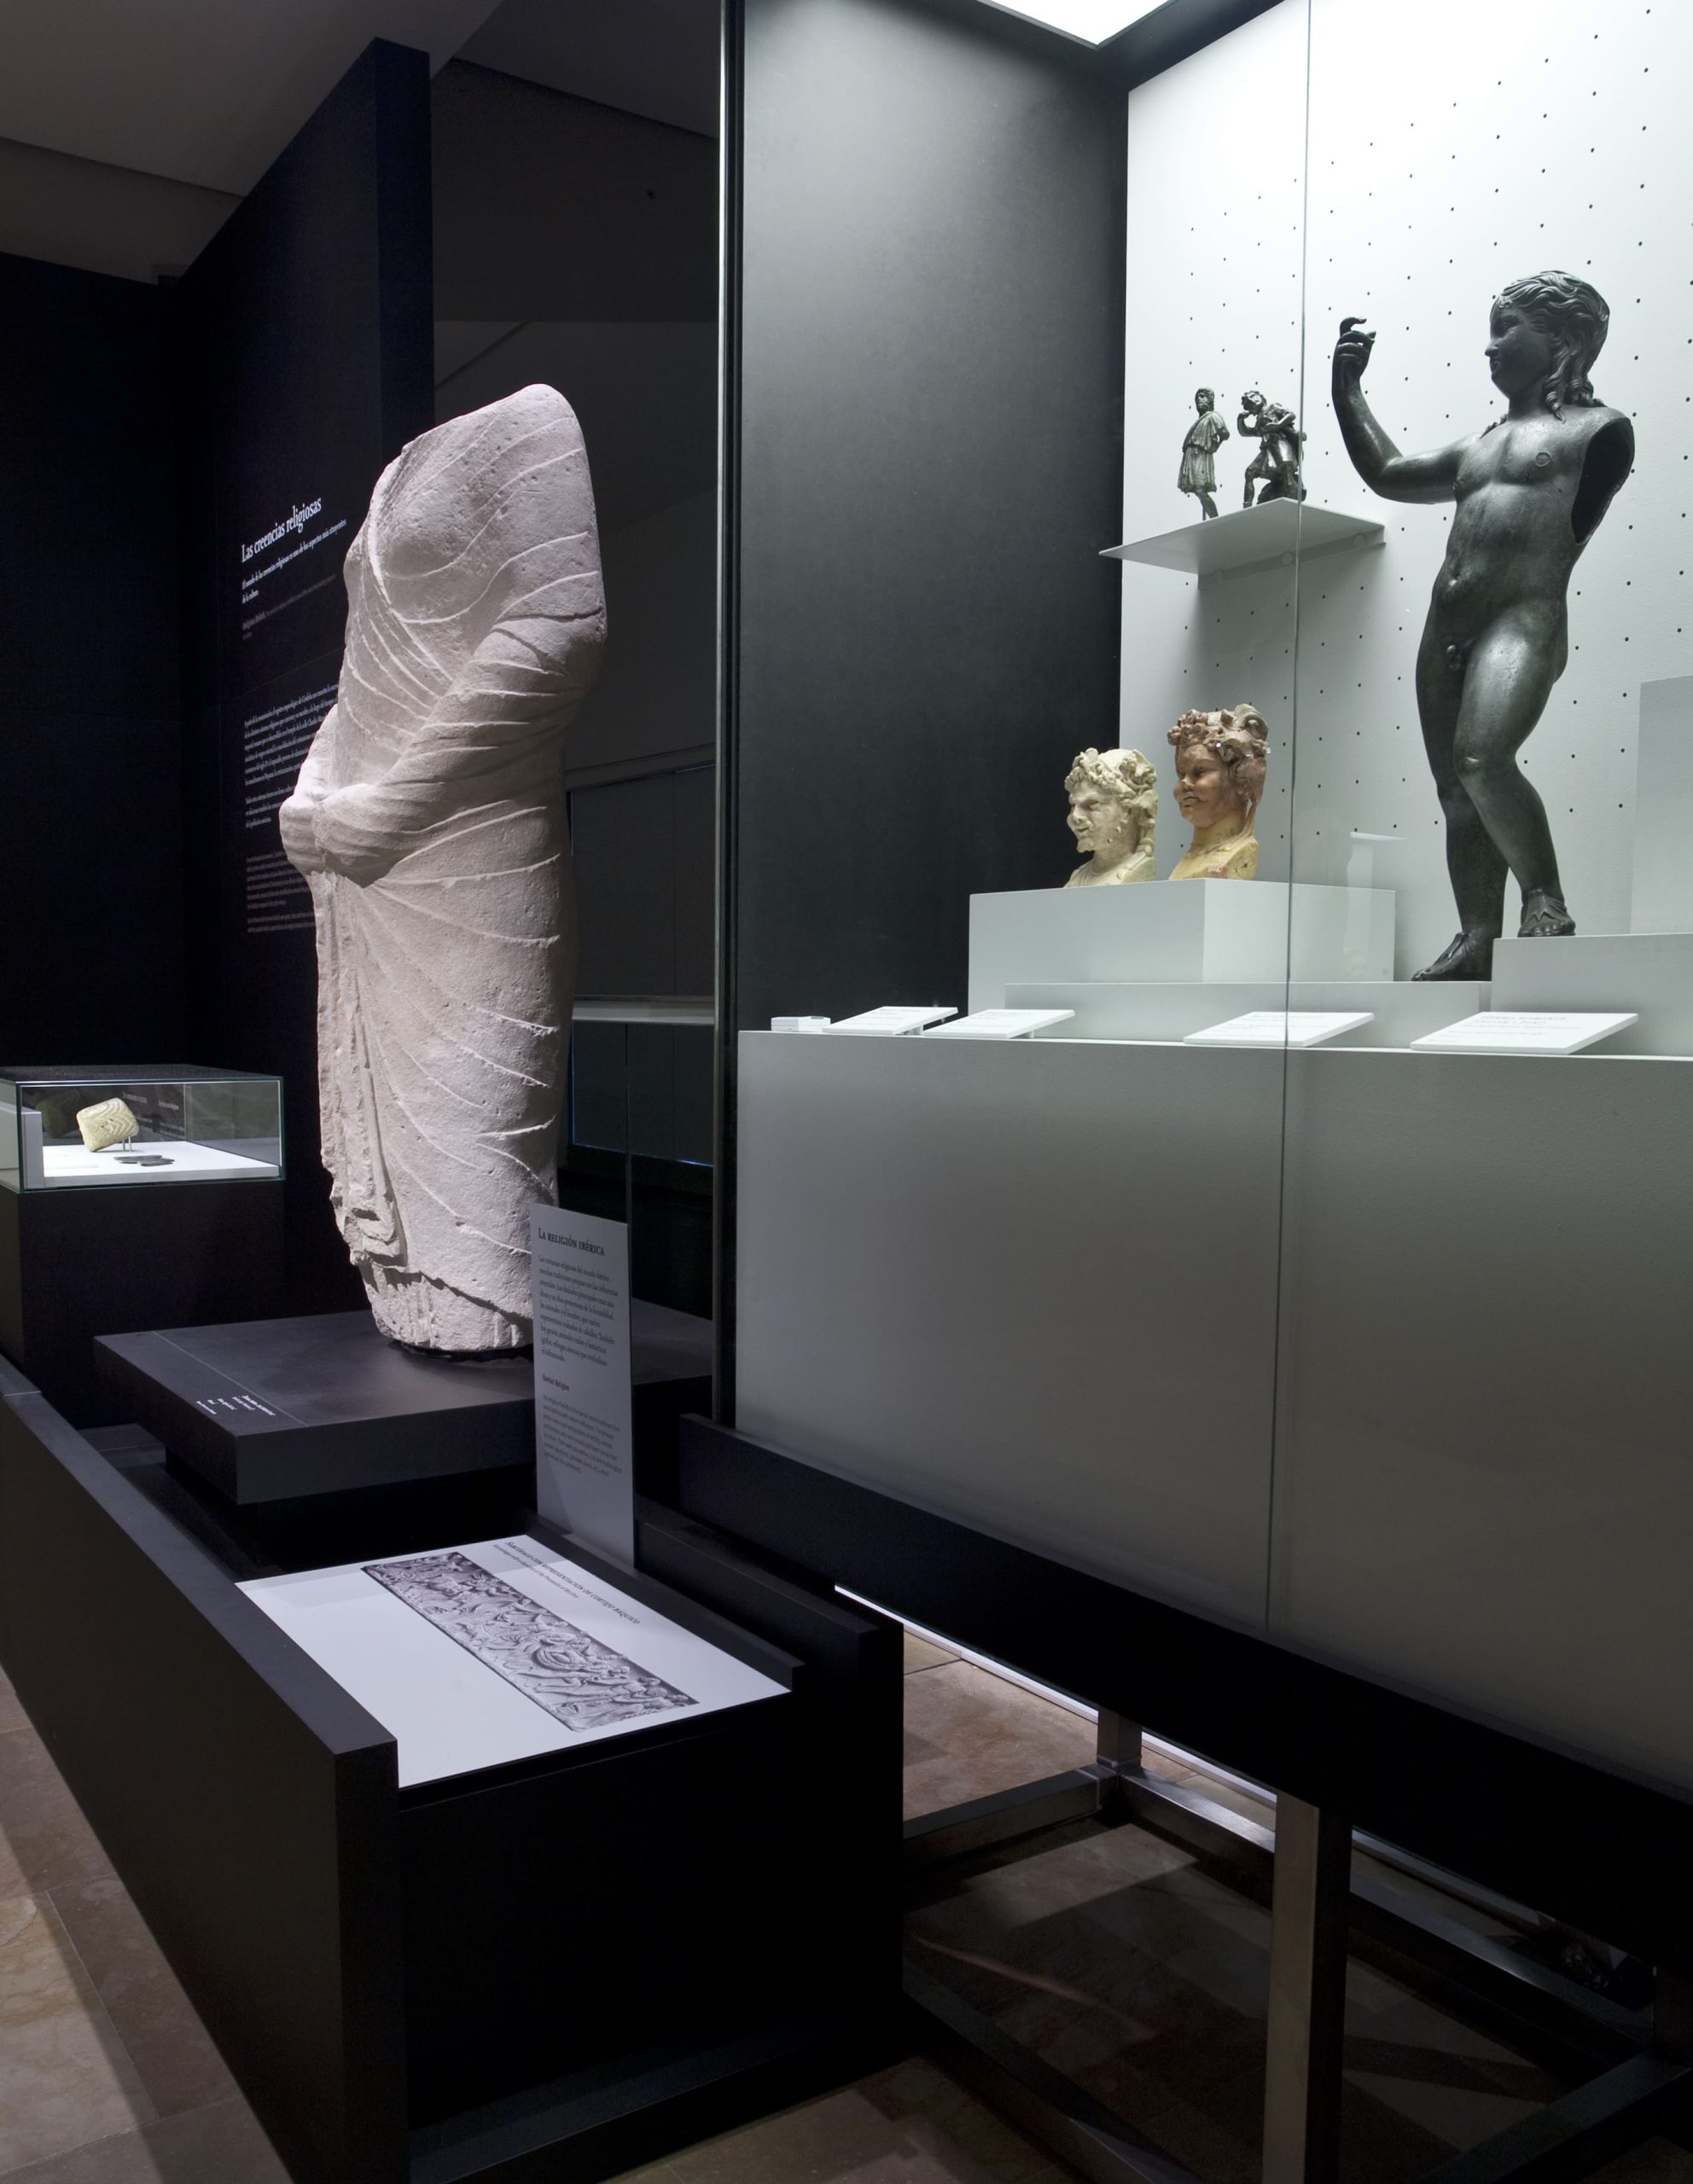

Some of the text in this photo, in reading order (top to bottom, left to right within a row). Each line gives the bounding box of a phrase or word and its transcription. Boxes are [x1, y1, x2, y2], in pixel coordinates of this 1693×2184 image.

[241, 497, 322, 563] Las creencias religiosas
[547, 1233, 577, 1249] RELIGIÓN
[578, 1238, 605, 1256] IBÉRICA
